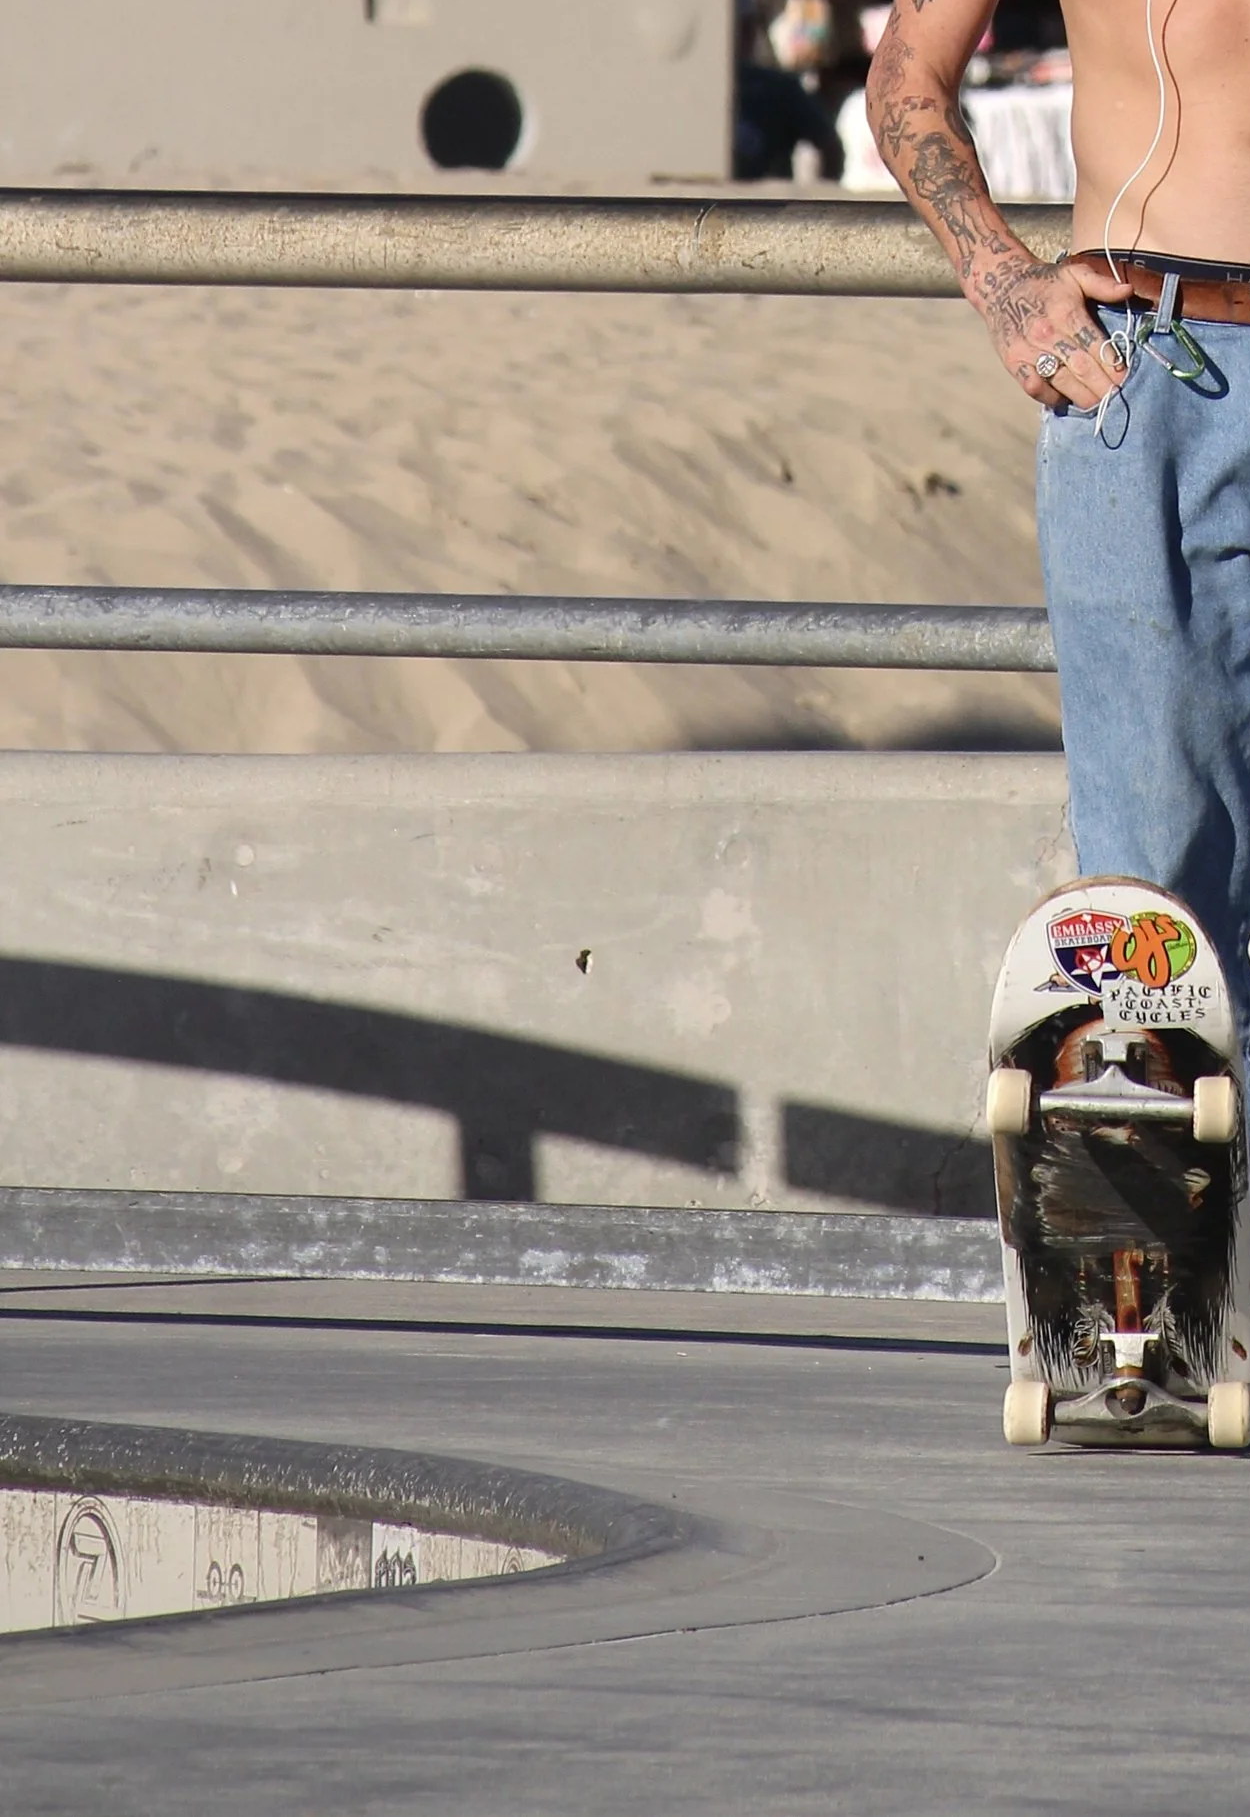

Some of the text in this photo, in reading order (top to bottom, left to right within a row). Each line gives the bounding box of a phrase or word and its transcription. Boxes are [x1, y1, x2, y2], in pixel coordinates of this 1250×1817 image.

[1053, 920, 1122, 938] EMBASSY
[1125, 997, 1197, 1010] COAST
[1118, 1007, 1206, 1025] CYCLES
